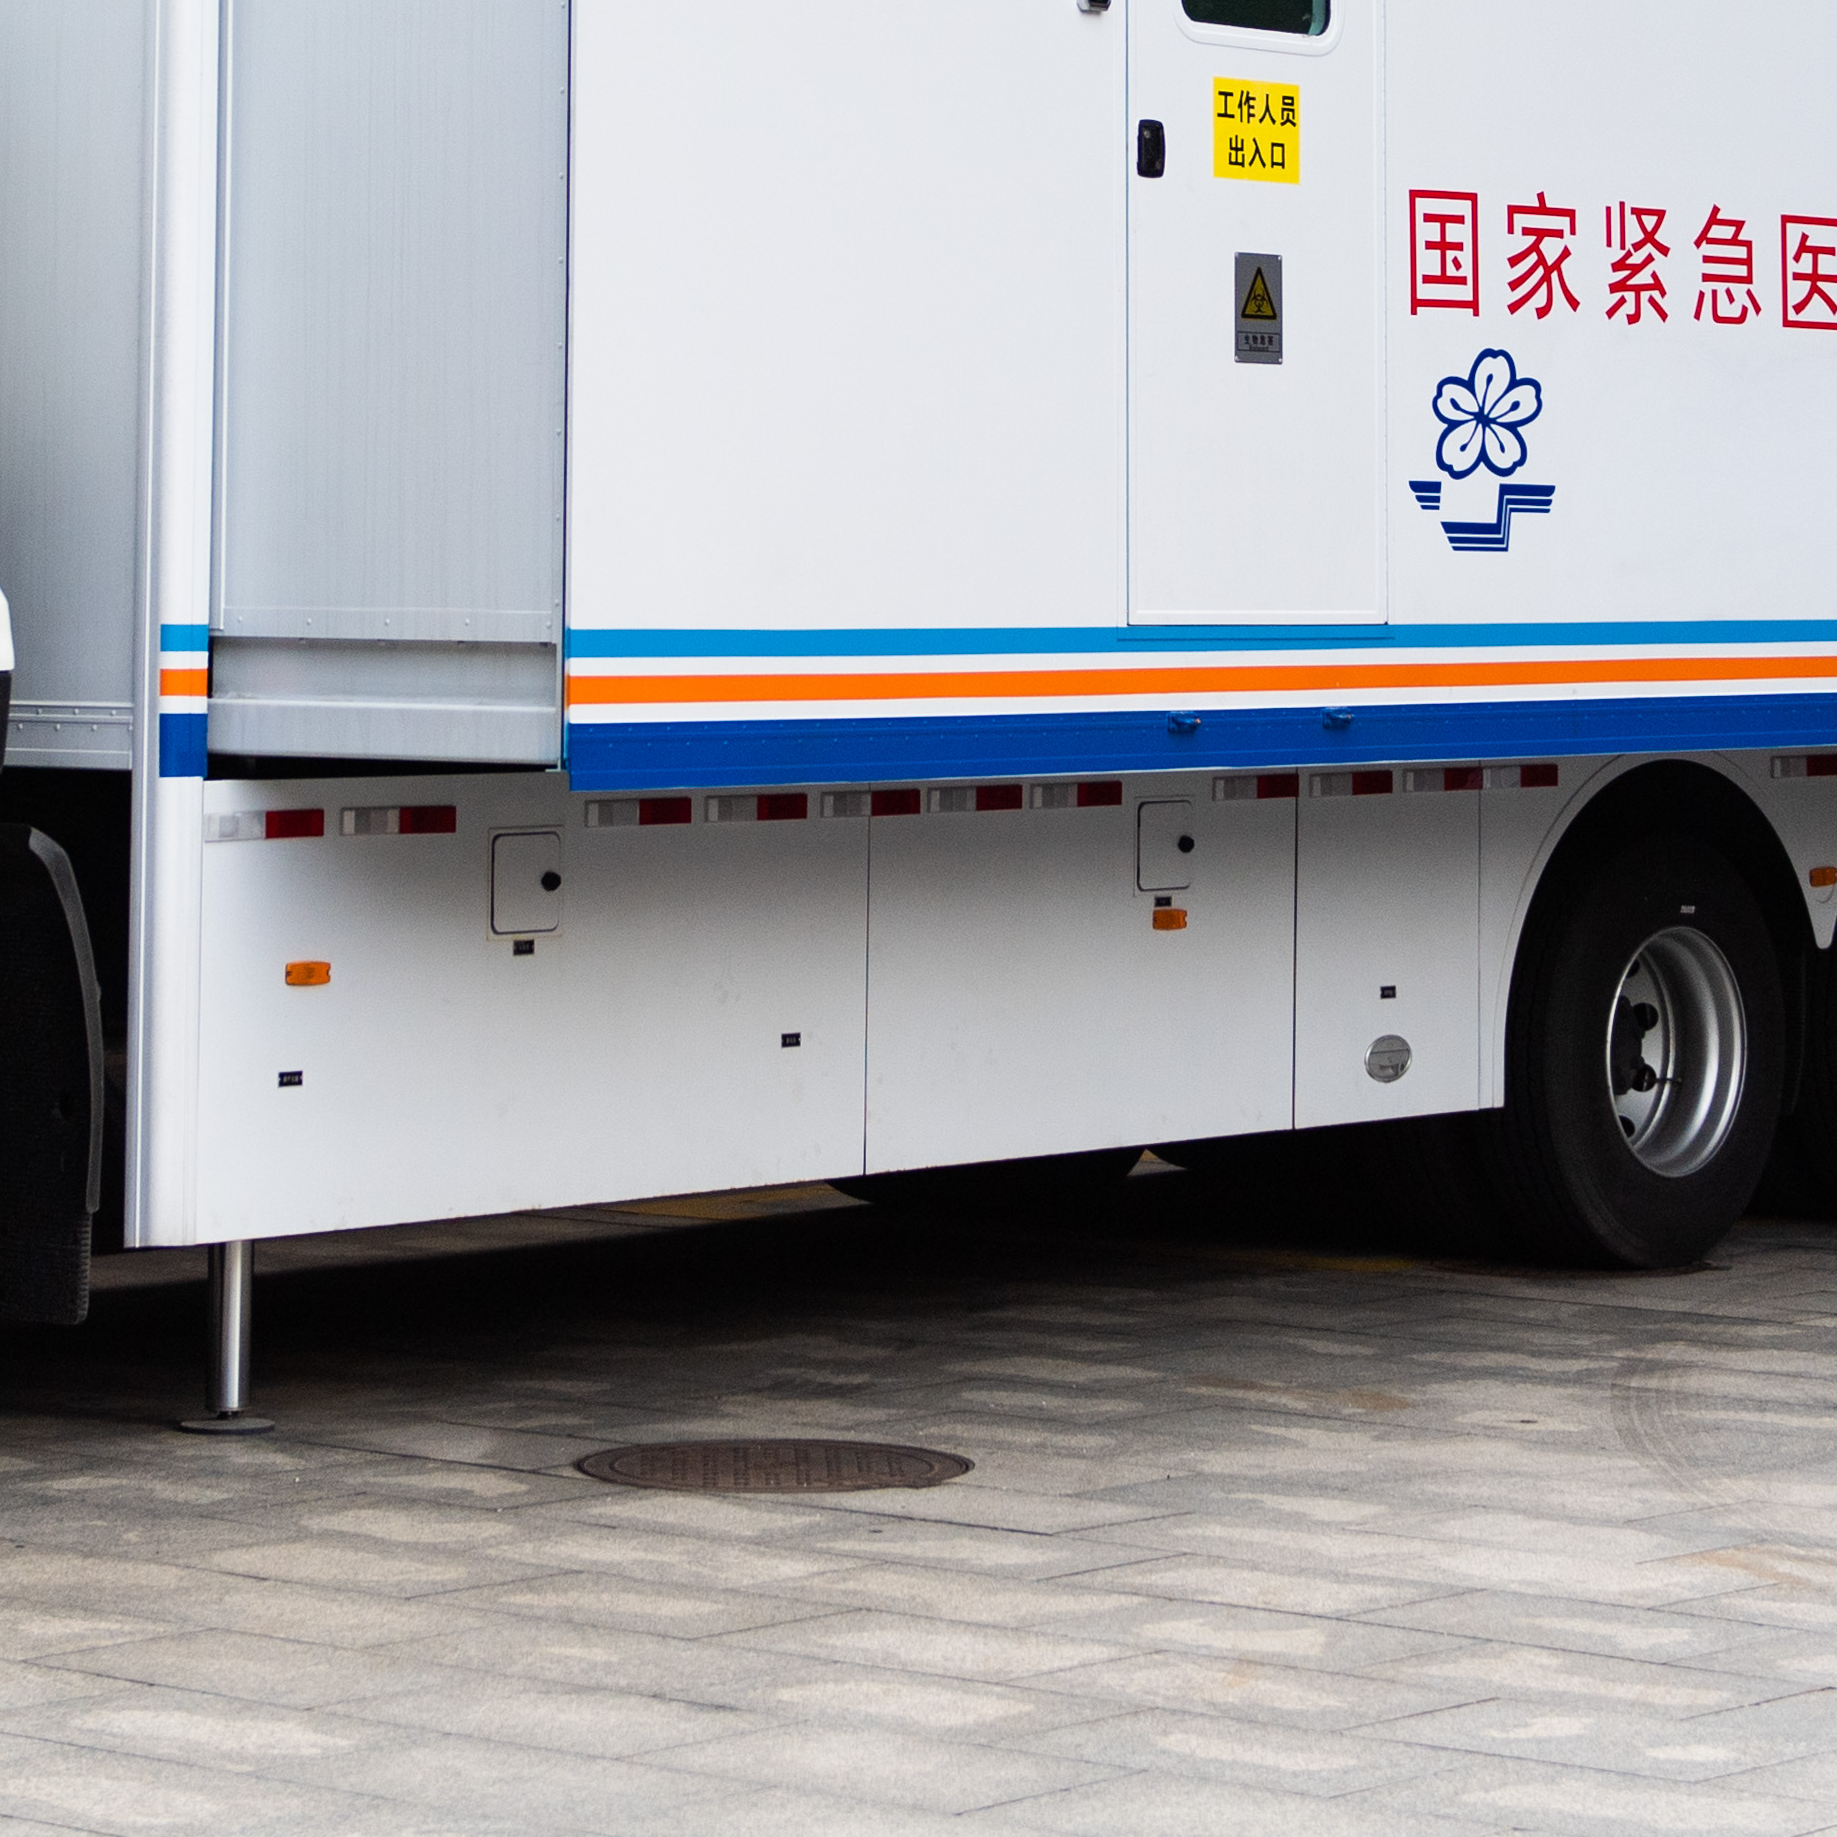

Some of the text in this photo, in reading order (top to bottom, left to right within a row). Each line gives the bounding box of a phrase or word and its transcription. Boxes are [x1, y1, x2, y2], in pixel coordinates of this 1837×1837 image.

[1217, 90, 1297, 128] 工作人员
[1228, 134, 1286, 170] 出入口
